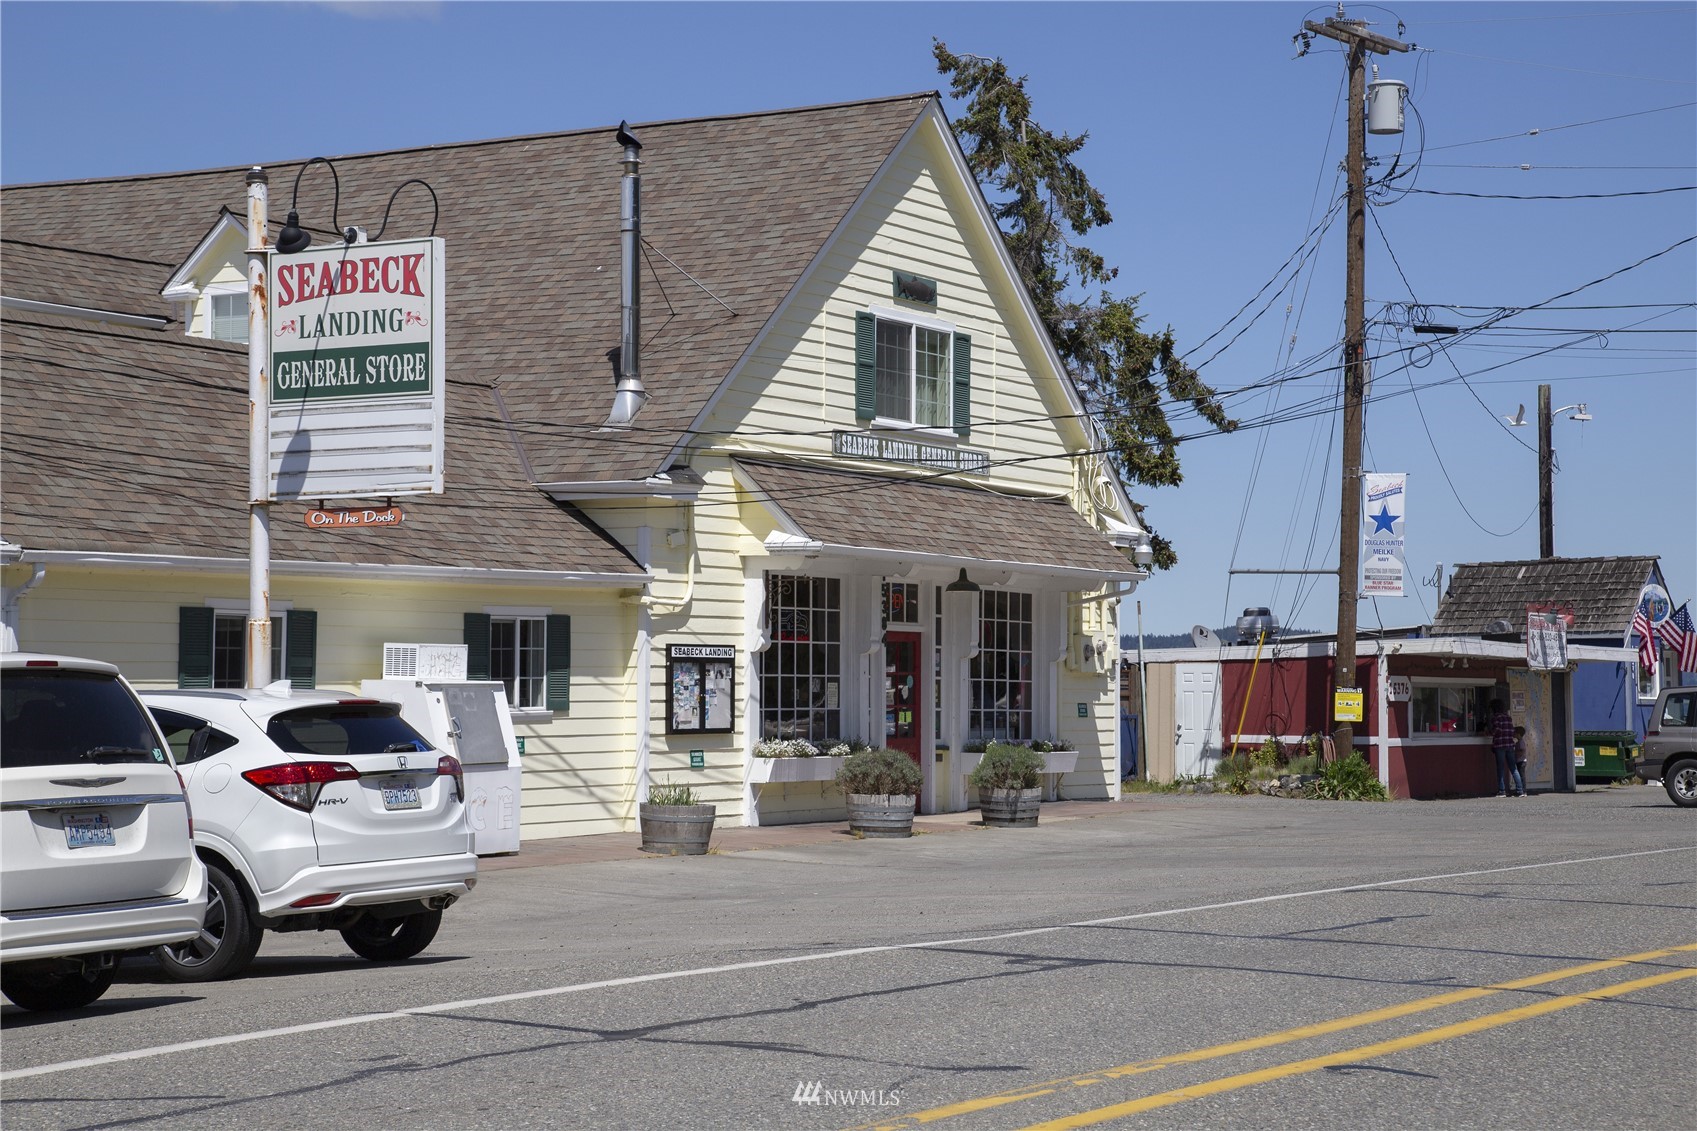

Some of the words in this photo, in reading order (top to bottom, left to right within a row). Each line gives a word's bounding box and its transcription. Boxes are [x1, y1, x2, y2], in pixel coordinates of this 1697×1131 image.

[277, 253, 426, 308] SEABECK
[298, 307, 405, 340] LANDING
[276, 357, 361, 390] GENERAL
[365, 353, 426, 385] STORE
[842, 434, 879, 458] SEABECK
[882, 440, 918, 462] LANDING
[921, 446, 957, 468] GENERAL
[311, 512, 334, 525] On
[337, 510, 359, 524] The
[363, 510, 396, 523] Dock
[674, 648, 703, 656] SEABECK
[318, 797, 349, 806] HR-V
